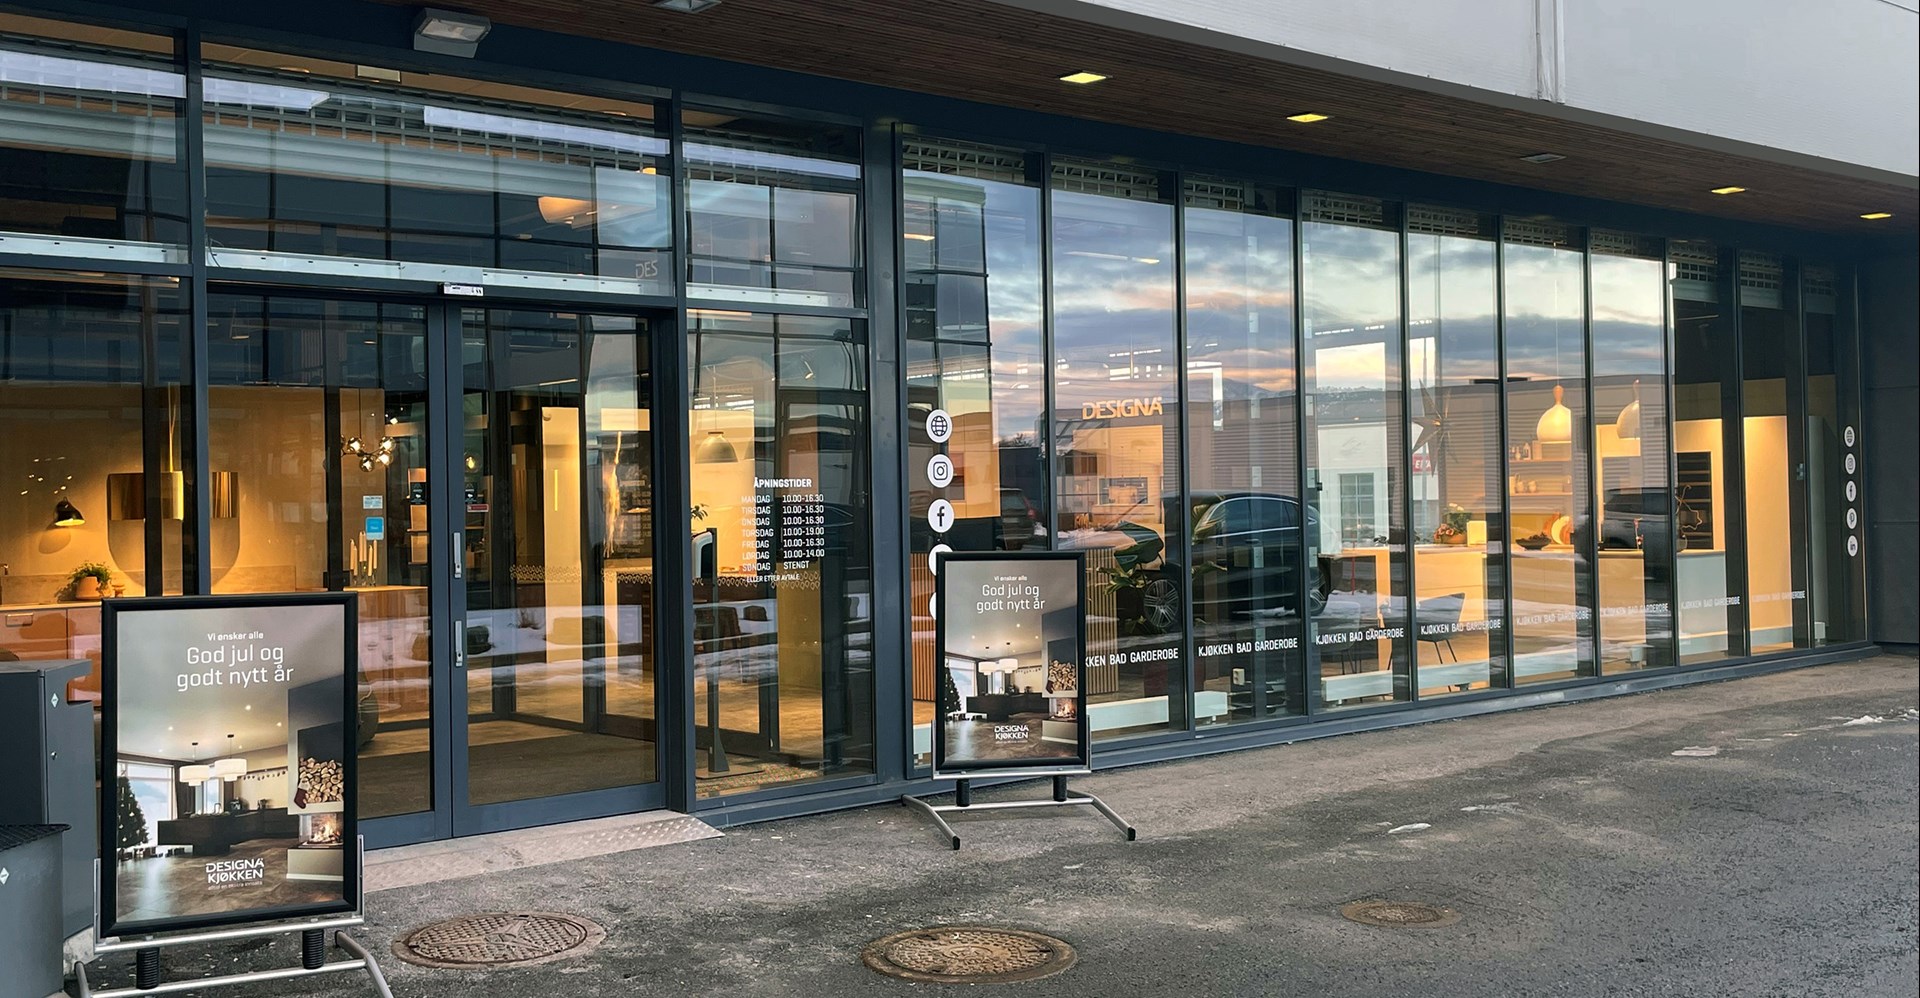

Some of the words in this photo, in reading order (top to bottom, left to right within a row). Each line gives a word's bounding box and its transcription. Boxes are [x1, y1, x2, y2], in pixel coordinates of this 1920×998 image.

[753, 477, 812, 488] ÅPNINGSTIDER
[741, 495, 771, 504] MANDAG
[782, 494, 824, 503] 10.00-16.30
[742, 506, 771, 515] TIRSDAG
[782, 505, 825, 514] 10.00-16.30
[742, 517, 770, 526] ONSDAG
[783, 516, 825, 525] 10.00-16.30
[742, 528, 774, 537] TORSDAG
[783, 527, 825, 536] 10.00-19.00
[742, 540, 770, 549] FREDAG
[783, 538, 825, 548] 10.00-16.30
[783, 549, 825, 559] 10.00-14.00
[783, 560, 809, 570] STENGT
[982, 584, 1005, 596] God
[1007, 584, 1021, 598] jul
[1025, 586, 1039, 598] og
[976, 599, 1004, 614] godt
[1007, 599, 1031, 613] nytt
[1033, 597, 1046, 610] år
[1420, 623, 1450, 635] KJØKKEN
[1451, 622, 1464, 633] BAD
[1466, 619, 1502, 631] GARDEROBE
[207, 633, 216, 641] Vi
[217, 632, 247, 641] ønsker
[248, 631, 264, 640] alle
[1315, 632, 1347, 645] KJØKKEN
[1349, 630, 1364, 642] BAD
[1365, 627, 1405, 641] GARDEROBE
[1198, 643, 1234, 657] KJØKKEN
[1236, 641, 1252, 654] BAD
[1255, 637, 1298, 651] GARDEROBE
[187, 645, 225, 665] God
[228, 644, 254, 667] jul
[260, 646, 284, 665] og
[1109, 653, 1127, 665] BAD
[1130, 648, 1179, 663] GARDEROBE
[177, 668, 223, 692] godt
[229, 667, 268, 689] nytt
[274, 664, 294, 682] år
[208, 868, 263, 884] KJØKKEN
